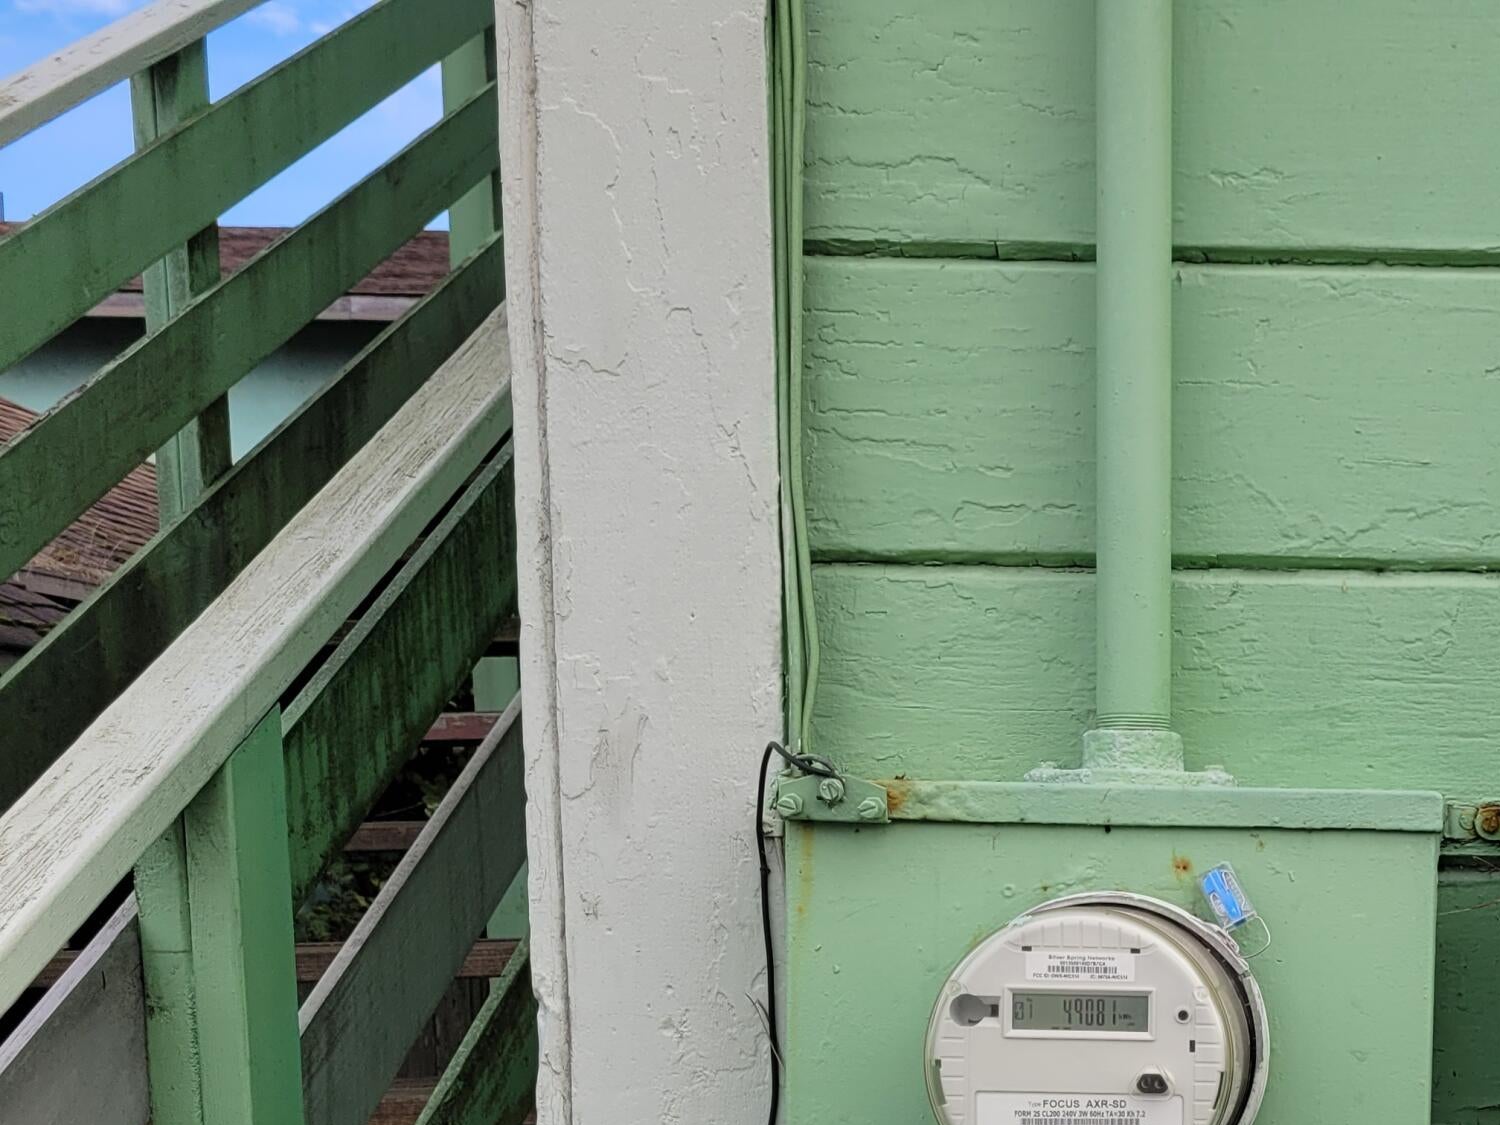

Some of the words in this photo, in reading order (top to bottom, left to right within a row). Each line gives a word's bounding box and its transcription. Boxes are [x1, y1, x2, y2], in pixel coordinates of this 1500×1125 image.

[1067, 954, 1086, 962] Spring
[1063, 998, 1117, 1026] 49081
[1042, 1099, 1080, 1108] FOCUS
[1086, 1099, 1127, 1109] AXR-SD
[1014, 1110, 1032, 1118] FORM
[1042, 1110, 1061, 1118] CL200
[1062, 1110, 1077, 1118] 240V
[1090, 1110, 1105, 1118] 60Hz
